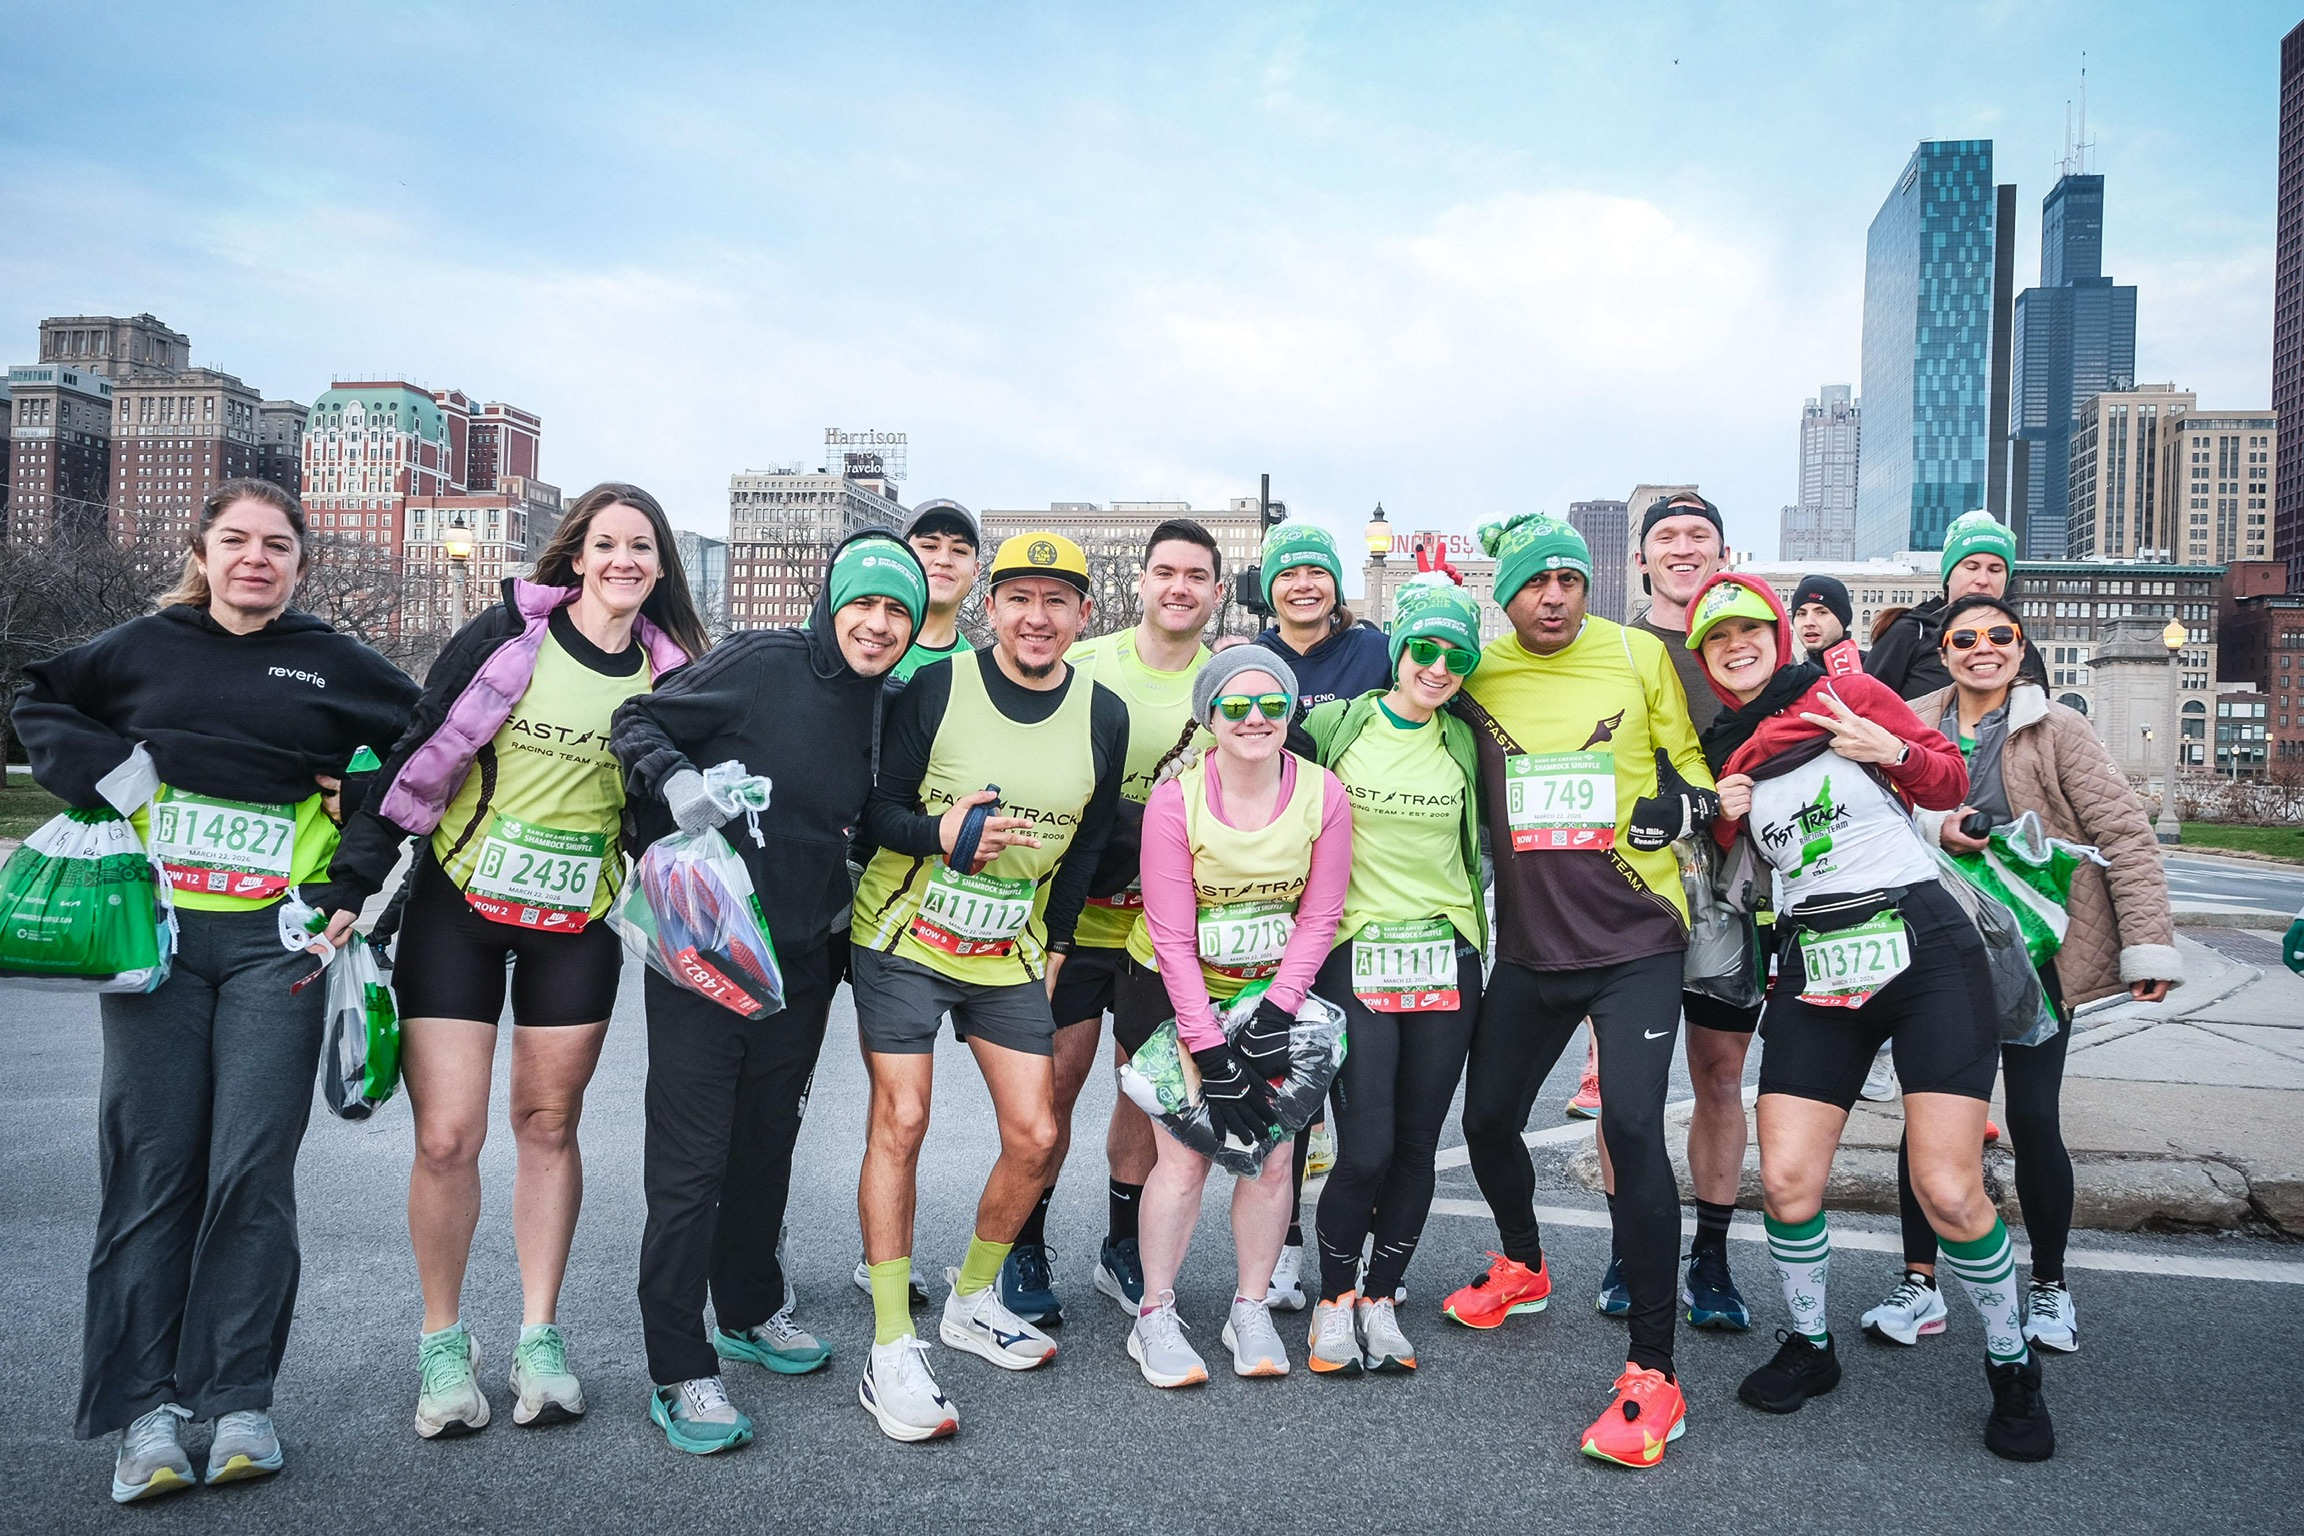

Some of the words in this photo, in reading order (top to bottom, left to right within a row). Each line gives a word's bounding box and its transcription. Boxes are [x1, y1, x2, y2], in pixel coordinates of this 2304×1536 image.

[824, 428, 907, 444] Harrison
[268, 666, 326, 688] reverie
[1314, 693, 1336, 703] CNO
[1484, 719, 1516, 751] FAST
[511, 742, 554, 757] RACING
[559, 752, 591, 764] TEAM
[1534, 763, 1569, 771] SHAMROCK
[1570, 762, 1601, 770] SHUFFLE
[1399, 794, 1458, 806] TRACK
[1511, 788, 1521, 811] B
[1543, 779, 1594, 810] 749
[1009, 805, 1079, 826] TRACK
[160, 812, 173, 842] B
[186, 810, 290, 857] 14827
[526, 828, 545, 836] BANK
[553, 834, 579, 842] AMERICA
[1646, 827, 1665, 835] Mile
[1761, 821, 1795, 851] FAST
[1789, 801, 1852, 834] TRACK
[1799, 829, 1824, 846] RACING
[1827, 820, 1849, 834] TEAM
[524, 834, 565, 850] SHAMROCK
[565, 843, 593, 853] SHUFFLE
[1042, 832, 1065, 840] 2009
[1517, 835, 1532, 843] ROW
[1534, 834, 1539, 842] 1
[189, 849, 216, 859] MARCH
[218, 853, 230, 861] 22,
[232, 854, 251, 863] 2026
[482, 850, 501, 877] B
[186, 872, 199, 884] 12
[241, 876, 264, 886] RUN
[511, 853, 589, 894] 2436
[1611, 853, 1643, 892] TEAM
[508, 886, 533, 896] MARCH
[534, 890, 543, 899] 22,
[545, 893, 561, 901] 2026
[961, 878, 998, 894] SHAMROCK
[998, 888, 1023, 896] SHUFFLE
[474, 901, 500, 914] ROW
[501, 907, 509, 916] 2
[926, 893, 940, 913] A
[948, 895, 1027, 930] 11112
[1229, 907, 1261, 915] SHAMROCK
[1261, 904, 1284, 912] SHUFFLE
[550, 912, 568, 921] RUN
[919, 926, 941, 940] ROW
[941, 935, 948, 943] 9
[948, 921, 968, 933] MARCH
[1231, 918, 1288, 954] 2778
[1383, 931, 1418, 939] SHAMROCK
[1419, 929, 1443, 938] SHUFFLE
[1206, 932, 1218, 956] D
[1358, 952, 1370, 975] A
[1377, 945, 1450, 975] 11117
[1819, 937, 1900, 978] 13721
[1808, 955, 1819, 981] C
[1860, 974, 1875, 982] 2026
[1383, 998, 1390, 1006] 9
